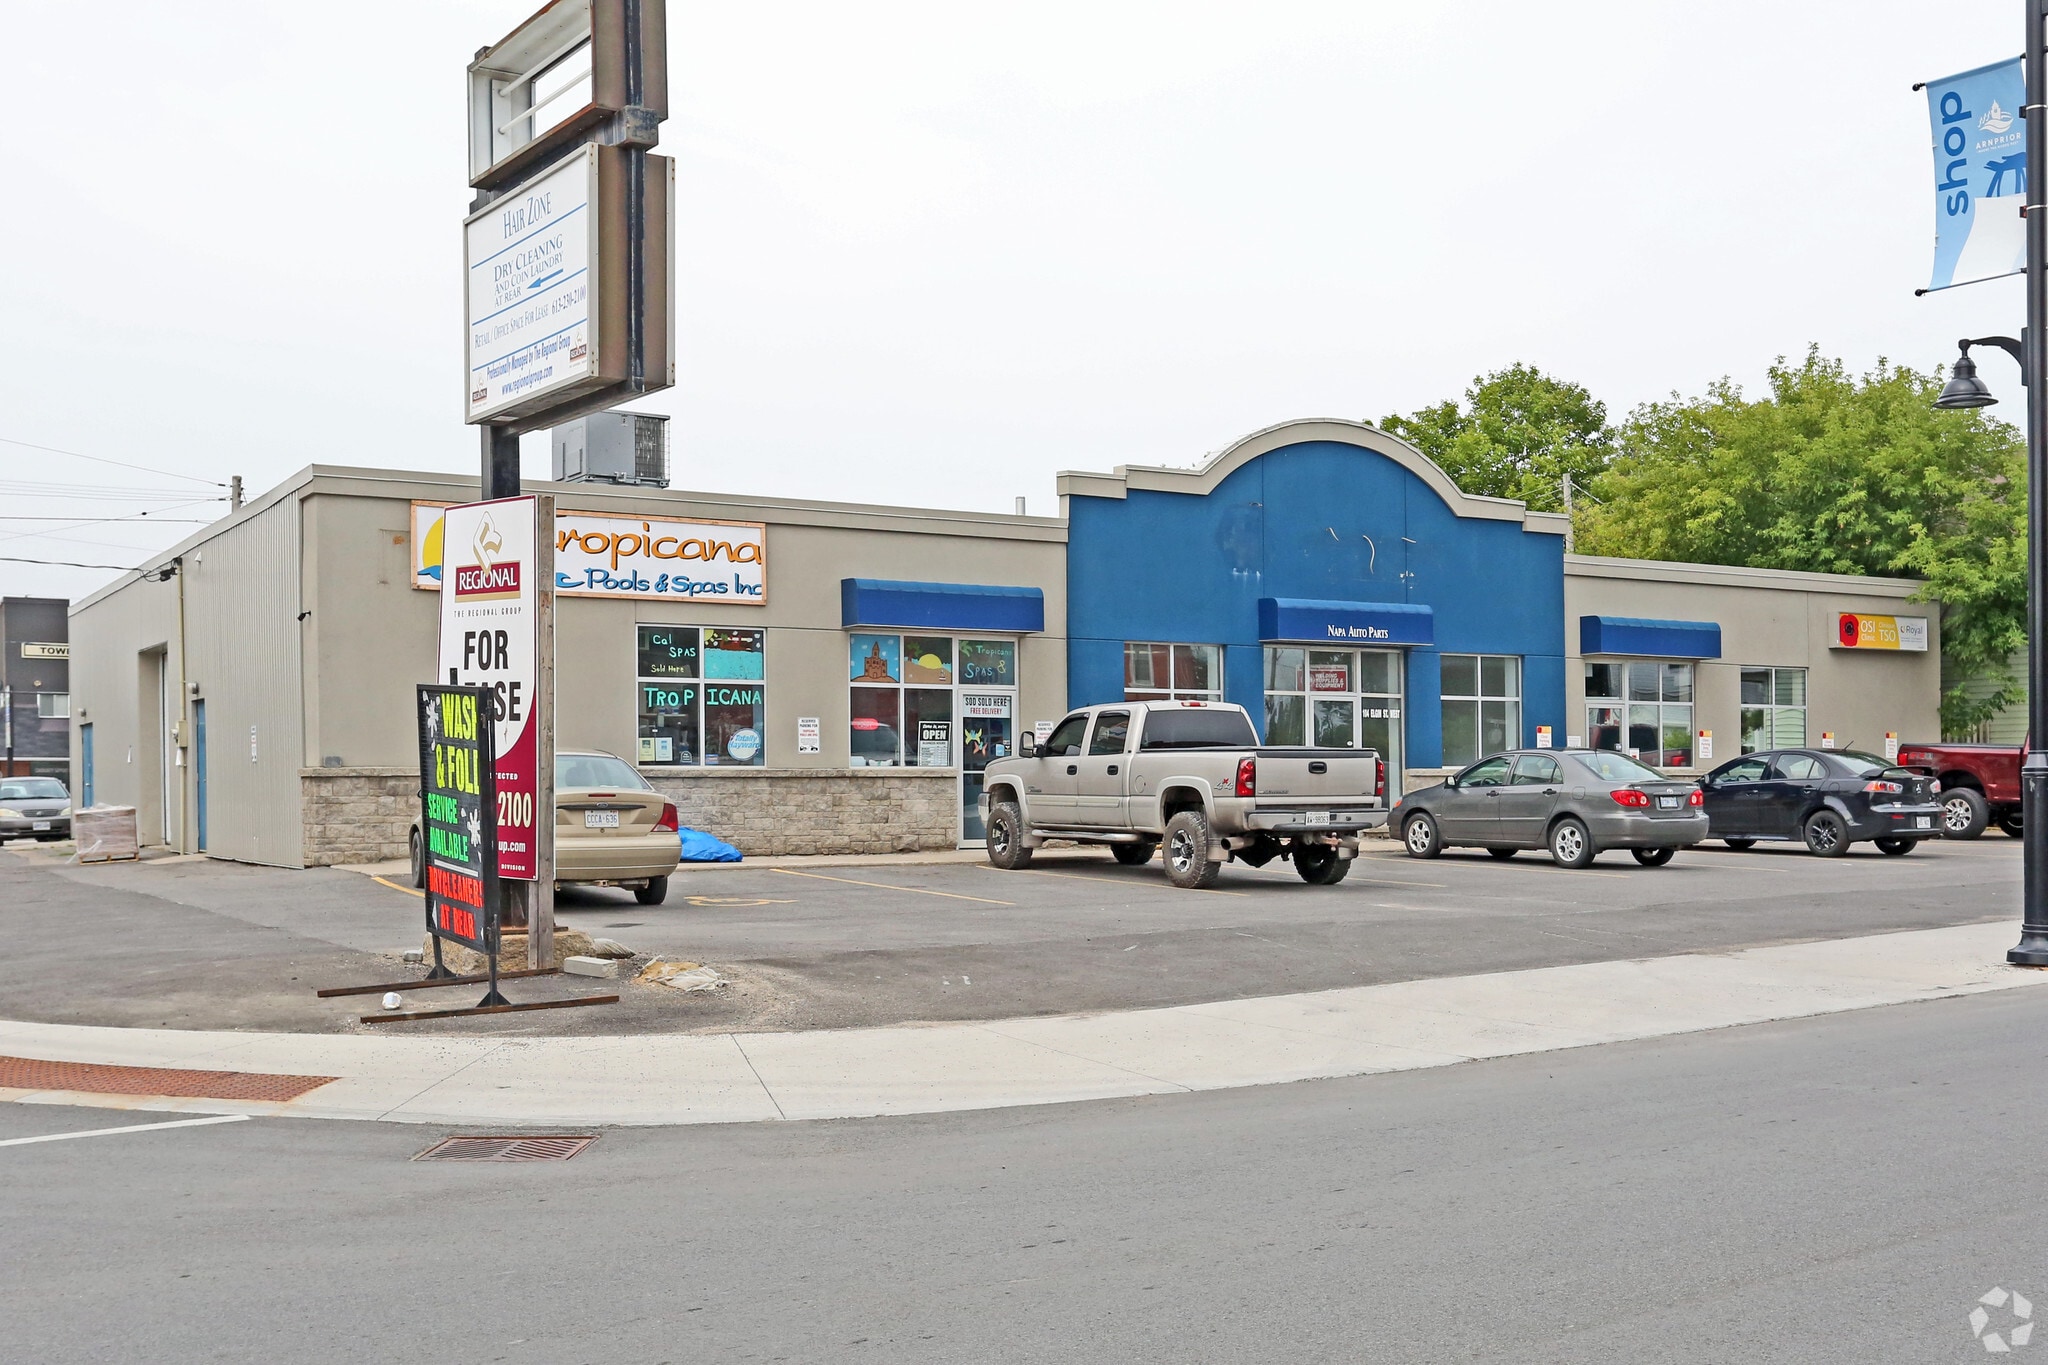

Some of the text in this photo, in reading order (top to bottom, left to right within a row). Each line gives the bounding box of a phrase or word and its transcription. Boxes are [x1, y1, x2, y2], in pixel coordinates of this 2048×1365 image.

[1975, 132, 2021, 150] ARNPRIOR
[1938, 91, 1972, 216] shop
[503, 192, 552, 239] HAIR ZONE
[494, 233, 563, 282] DRY CLEANING
[495, 251, 564, 296] AND COIN LAUNDRY
[504, 286, 522, 303] REAR
[556, 521, 762, 570] ropicana
[459, 567, 518, 591] REGIONAL
[584, 568, 762, 597] Pools & Spas Inc
[454, 606, 522, 618] THE REGIONAL GROUP
[1860, 620, 1876, 632] OSI
[1905, 625, 1923, 636] Royal
[652, 633, 672, 645] Cal
[1860, 633, 1876, 641] Clinic
[1879, 629, 1896, 642] TSO
[464, 630, 509, 670] FOR
[669, 646, 697, 658] SPAS
[650, 664, 684, 673] Sold Here
[997, 660, 1007, 673] &
[965, 697, 1007, 707] SOD SOLD HERE
[981, 707, 1002, 715] DELIVERY
[922, 729, 947, 740] OPEN
[435, 743, 445, 789] &
[496, 772, 518, 780] ECTED
[427, 792, 458, 825] SERVICE
[429, 826, 469, 862] AVAILABLE
[501, 864, 525, 872] DIVISION
[440, 903, 476, 941] AT REAR
